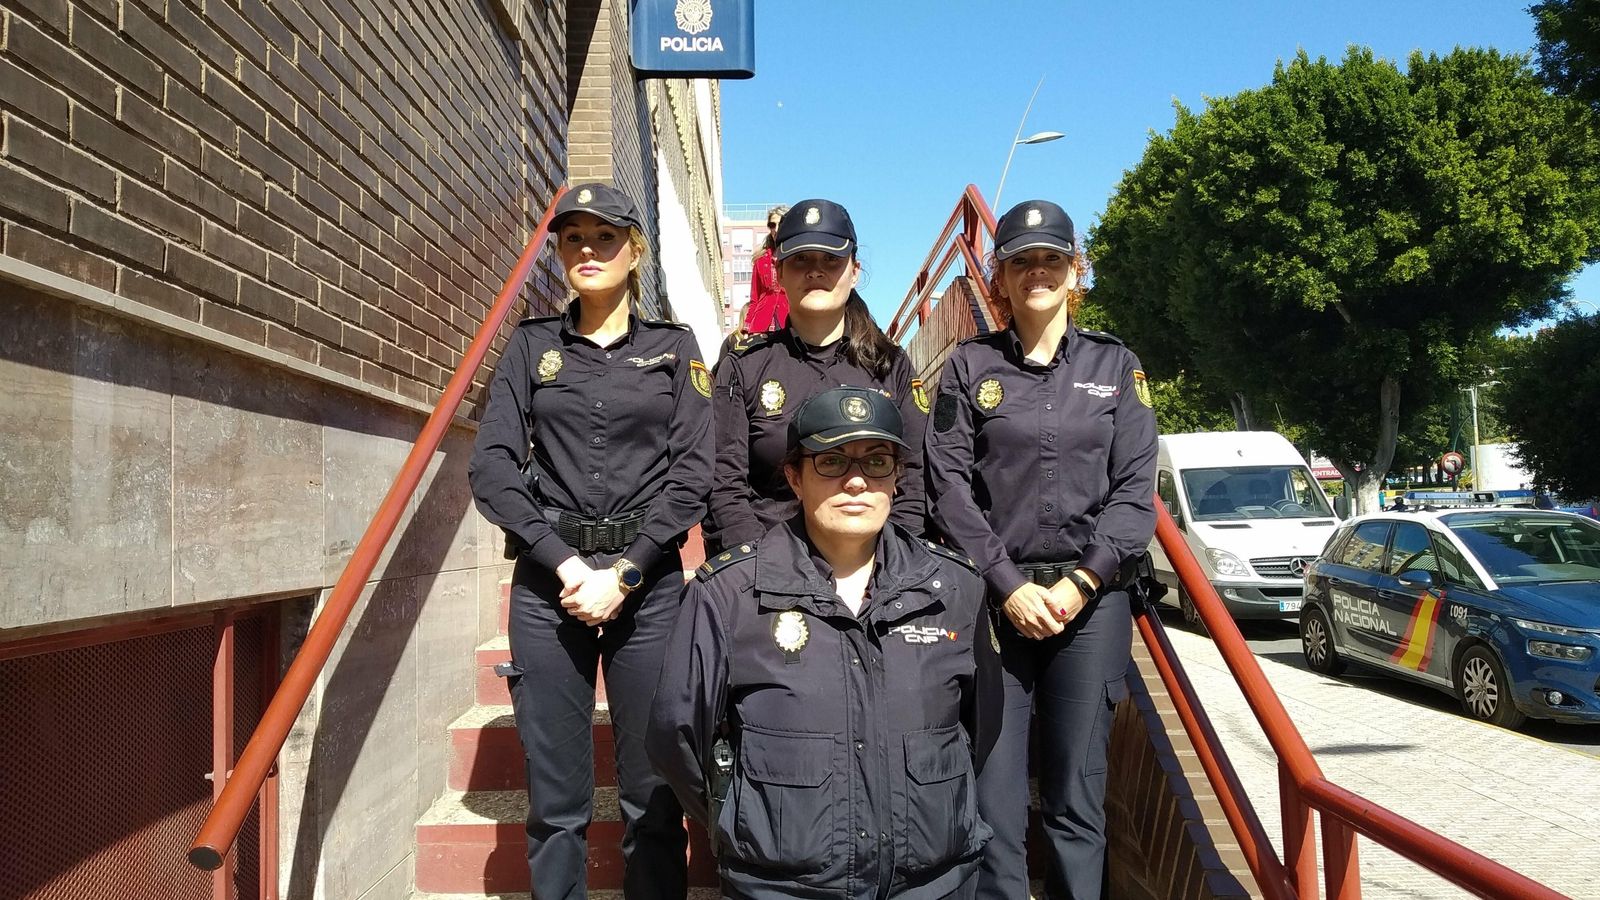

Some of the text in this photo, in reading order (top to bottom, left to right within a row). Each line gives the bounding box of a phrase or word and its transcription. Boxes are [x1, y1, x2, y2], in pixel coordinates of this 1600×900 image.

[660, 36, 724, 52] POLICIA
[1334, 609, 1397, 636] NACIONAL
[904, 634, 938, 643] CNP
